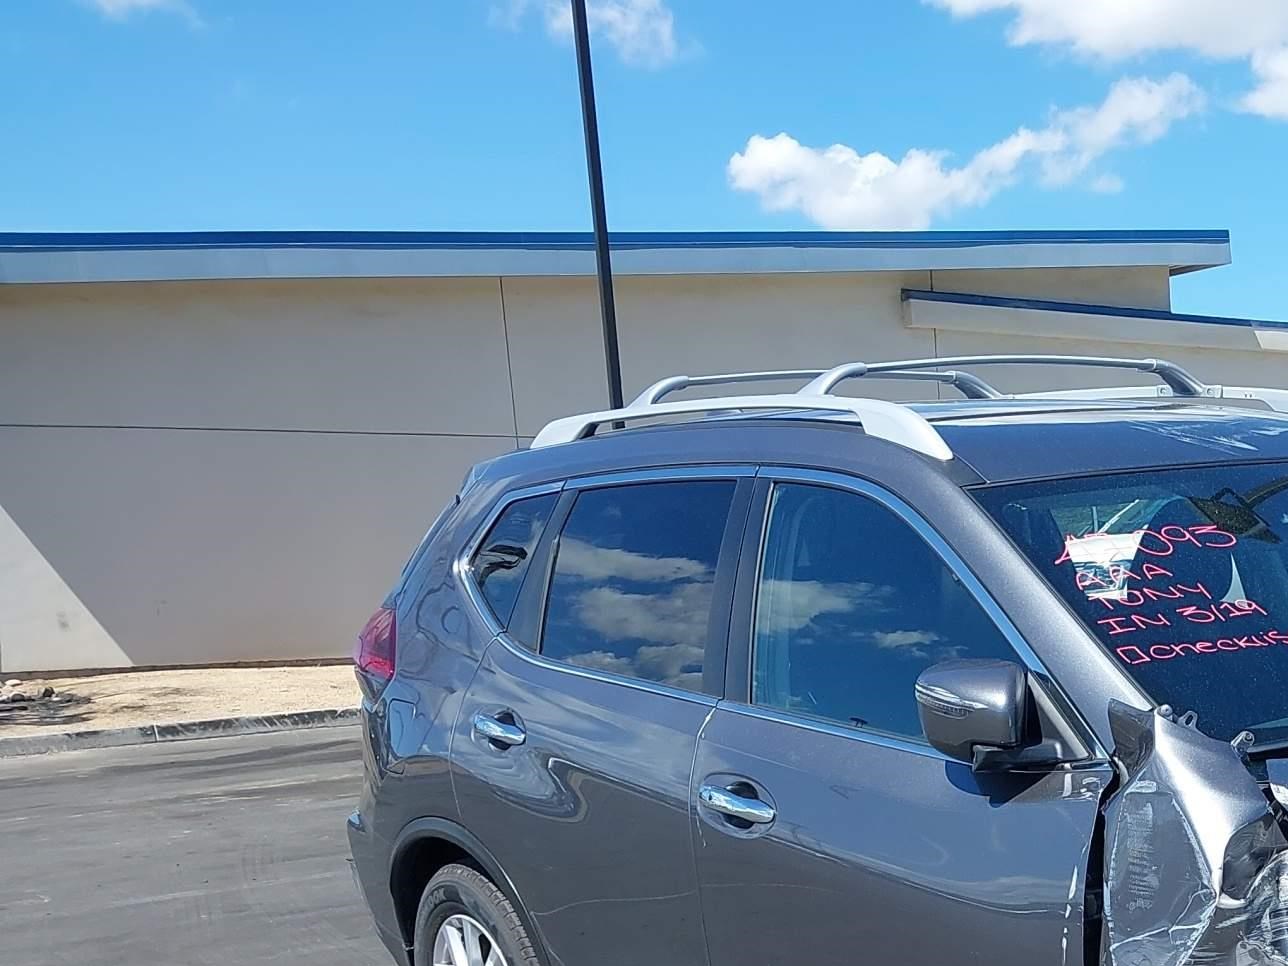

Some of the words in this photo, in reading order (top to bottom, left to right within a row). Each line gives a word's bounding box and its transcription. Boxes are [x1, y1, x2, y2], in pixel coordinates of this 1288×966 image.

[1075, 562, 1173, 591] AAA
[1087, 581, 1213, 610] TONY
[1097, 613, 1172, 635] IN
[1176, 598, 1268, 624] 3/19
